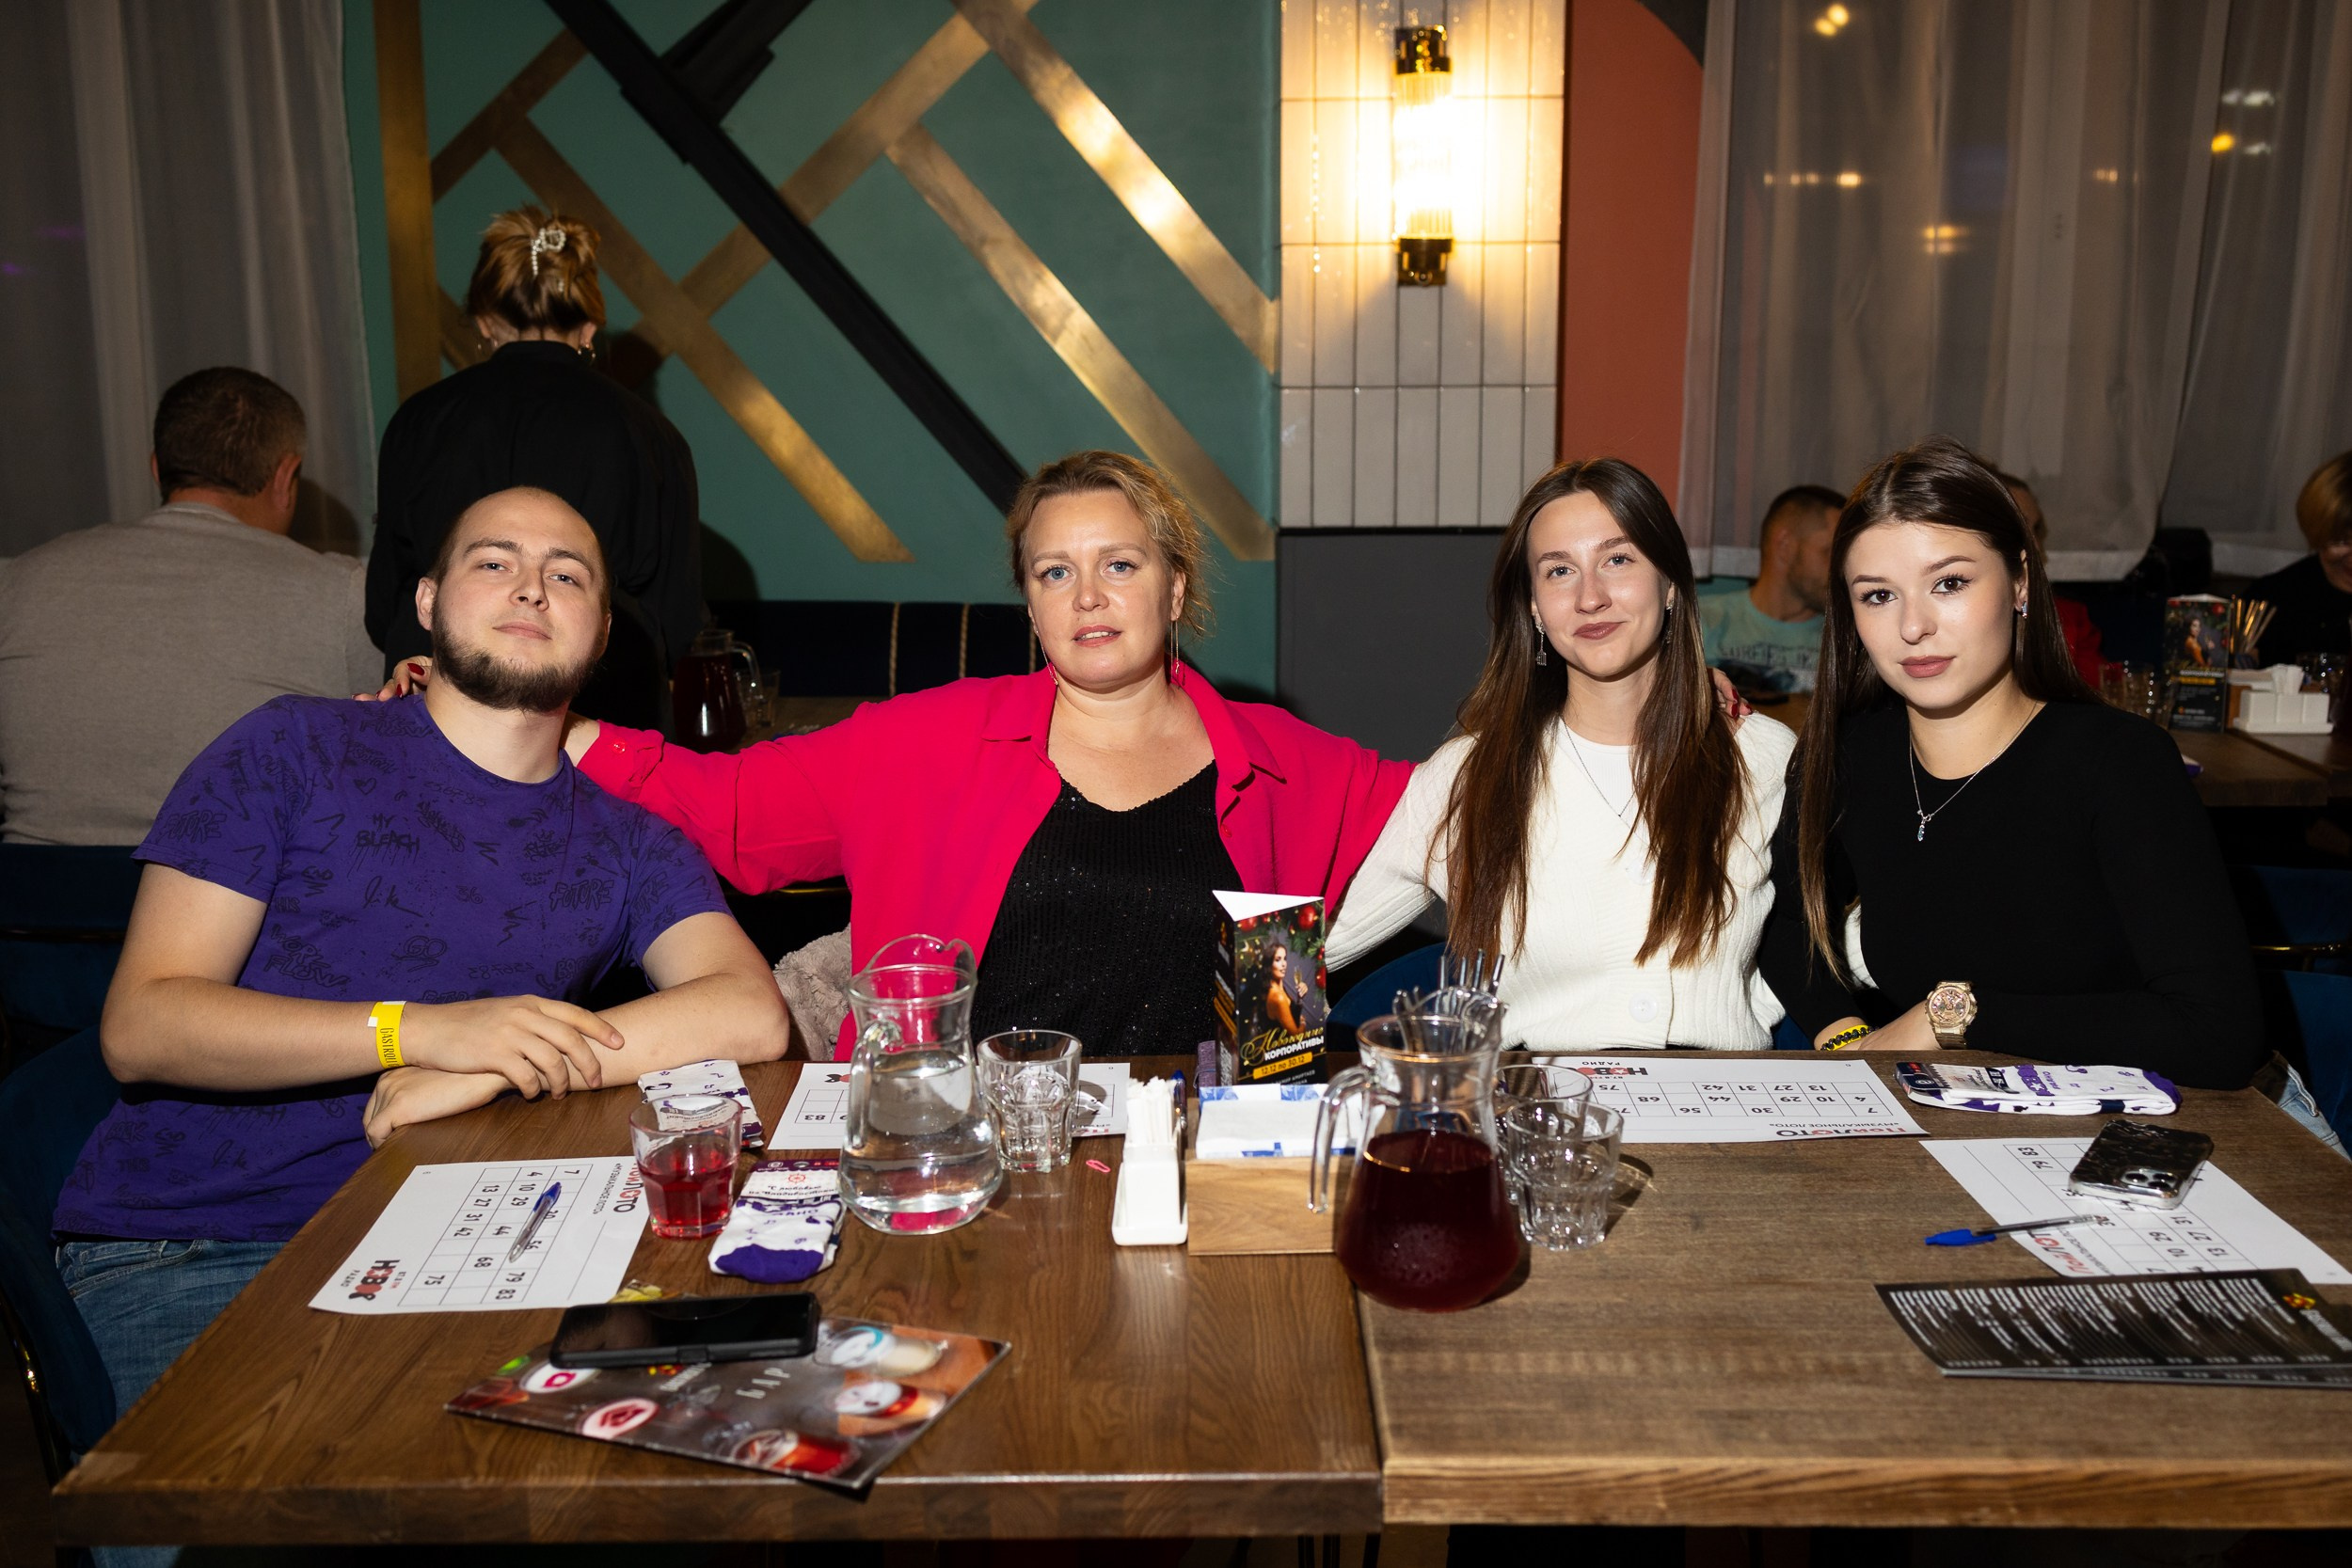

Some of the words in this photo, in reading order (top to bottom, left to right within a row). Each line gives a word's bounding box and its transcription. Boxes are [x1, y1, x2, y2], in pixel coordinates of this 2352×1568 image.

[357, 830, 421, 855] BLEACH
[548, 879, 615, 912] FUTURE
[1264, 1036, 1324, 1061] КОРПОРАТИВЫ
[1565, 1067, 1648, 1076] НОВО
[2018, 1147, 2039, 1156] 83
[2032, 1160, 2054, 1170] 79
[482, 1184, 500, 1193] 13
[518, 1183, 535, 1192] 10
[473, 1197, 492, 1208] 27
[511, 1196, 530, 1206] 29
[463, 1212, 483, 1223] 31
[2169, 1215, 2194, 1226] 31
[453, 1227, 473, 1238] 42
[492, 1226, 512, 1236] 44
[2149, 1230, 2172, 1243] 29
[2187, 1230, 2213, 1242] 27
[2026, 1228, 2094, 1275] ПойЛОТ
[2167, 1247, 2189, 1258] 10
[2206, 1247, 2229, 1258] 13
[473, 1257, 493, 1268] 68
[423, 1275, 445, 1286] 75
[506, 1272, 526, 1283] 79
[495, 1289, 516, 1301] 83
